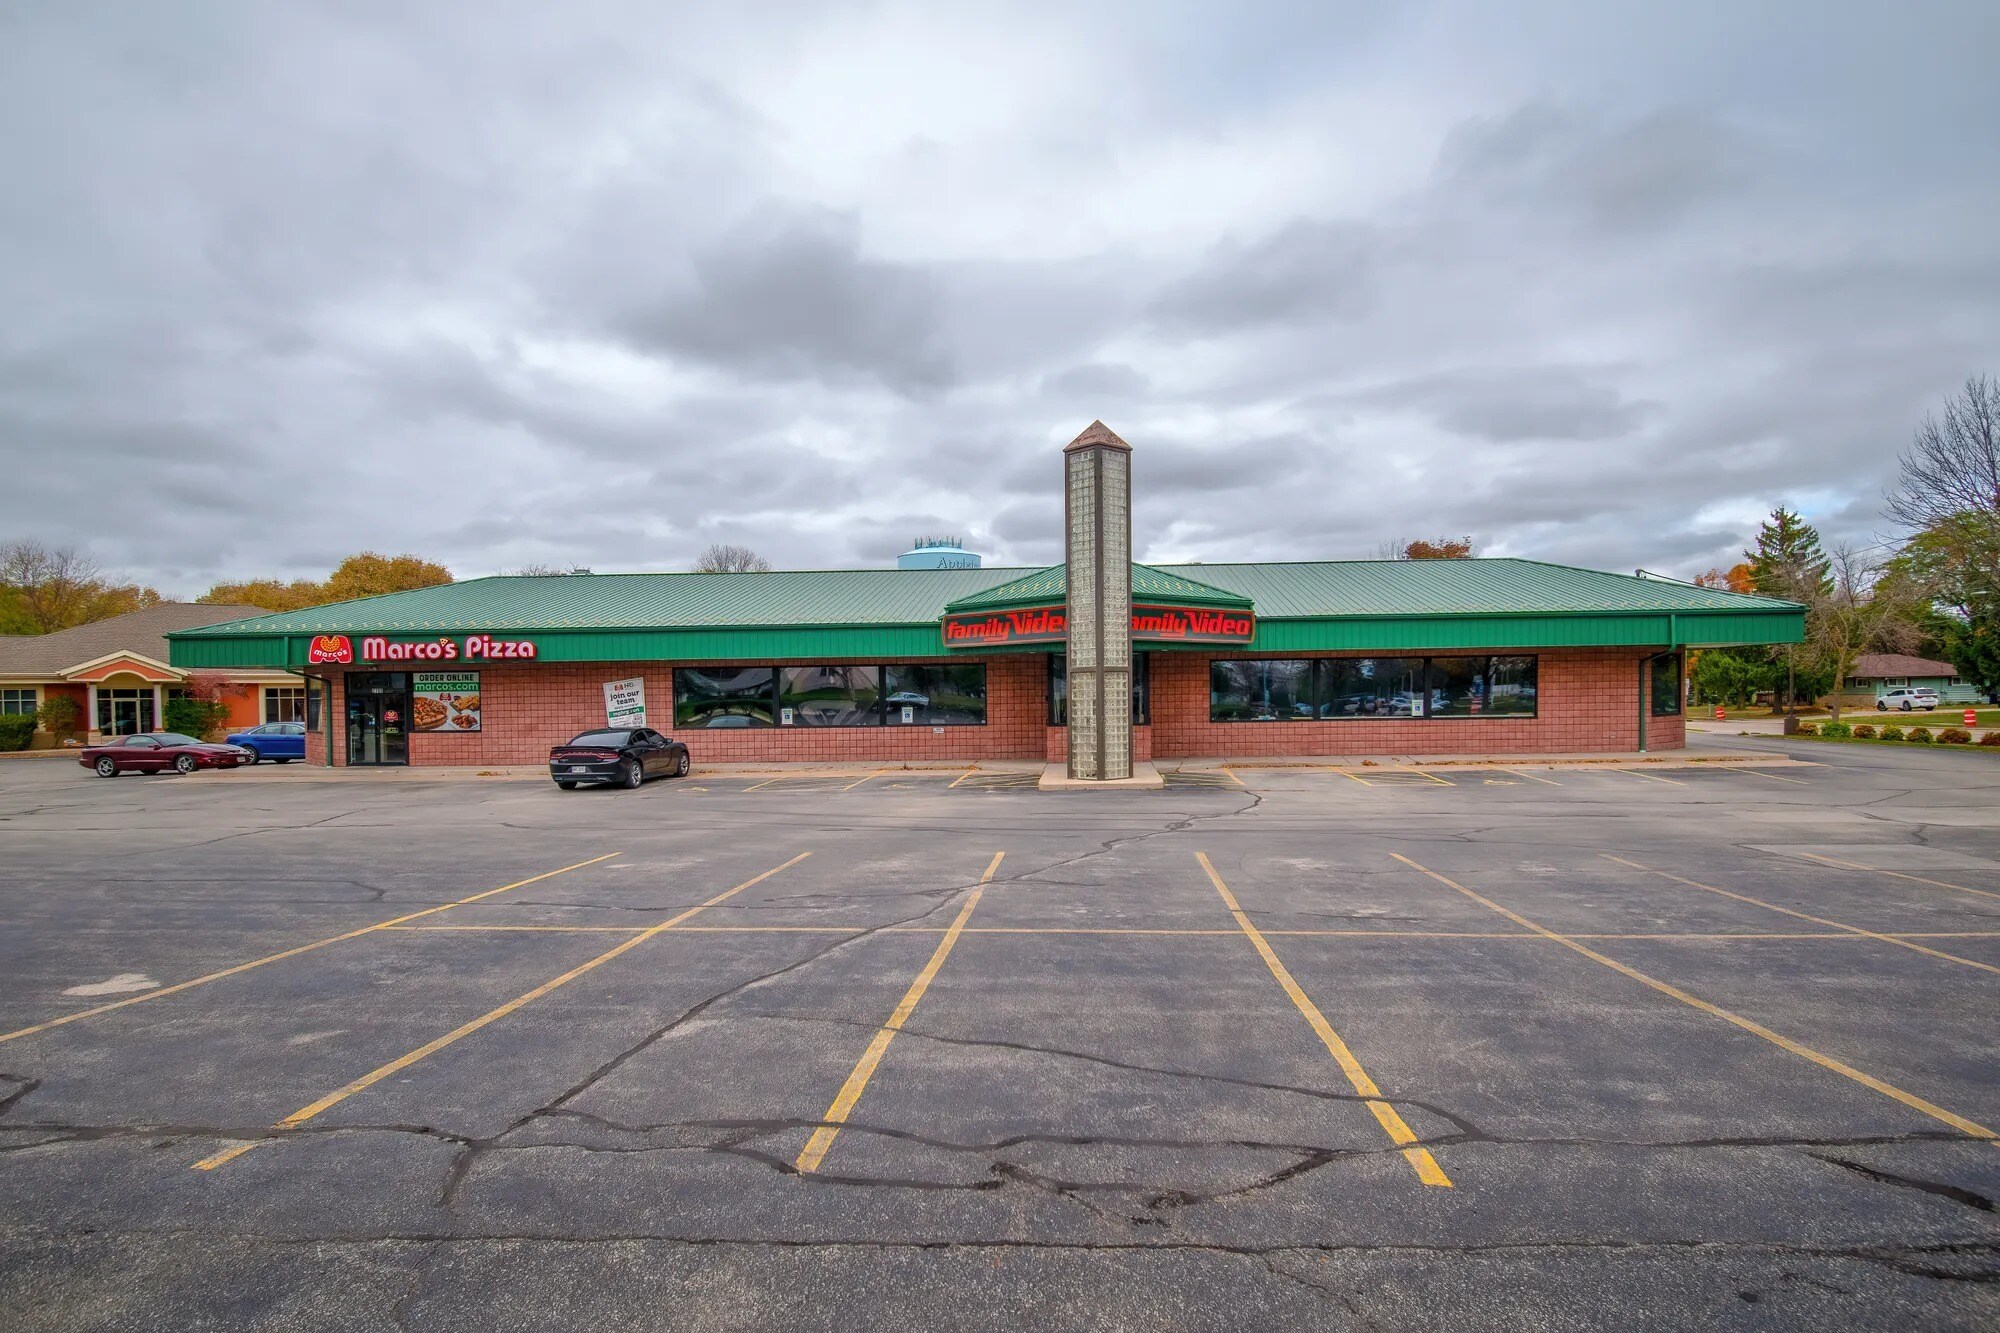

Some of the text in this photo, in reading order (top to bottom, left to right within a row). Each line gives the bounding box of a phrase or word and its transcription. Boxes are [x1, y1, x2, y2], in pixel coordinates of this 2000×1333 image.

[1131, 611, 1250, 637] amily Video
[465, 635, 535, 658] Pizza
[419, 673, 474, 682] ORDER ONLINE
[415, 683, 478, 691] marcos.com
